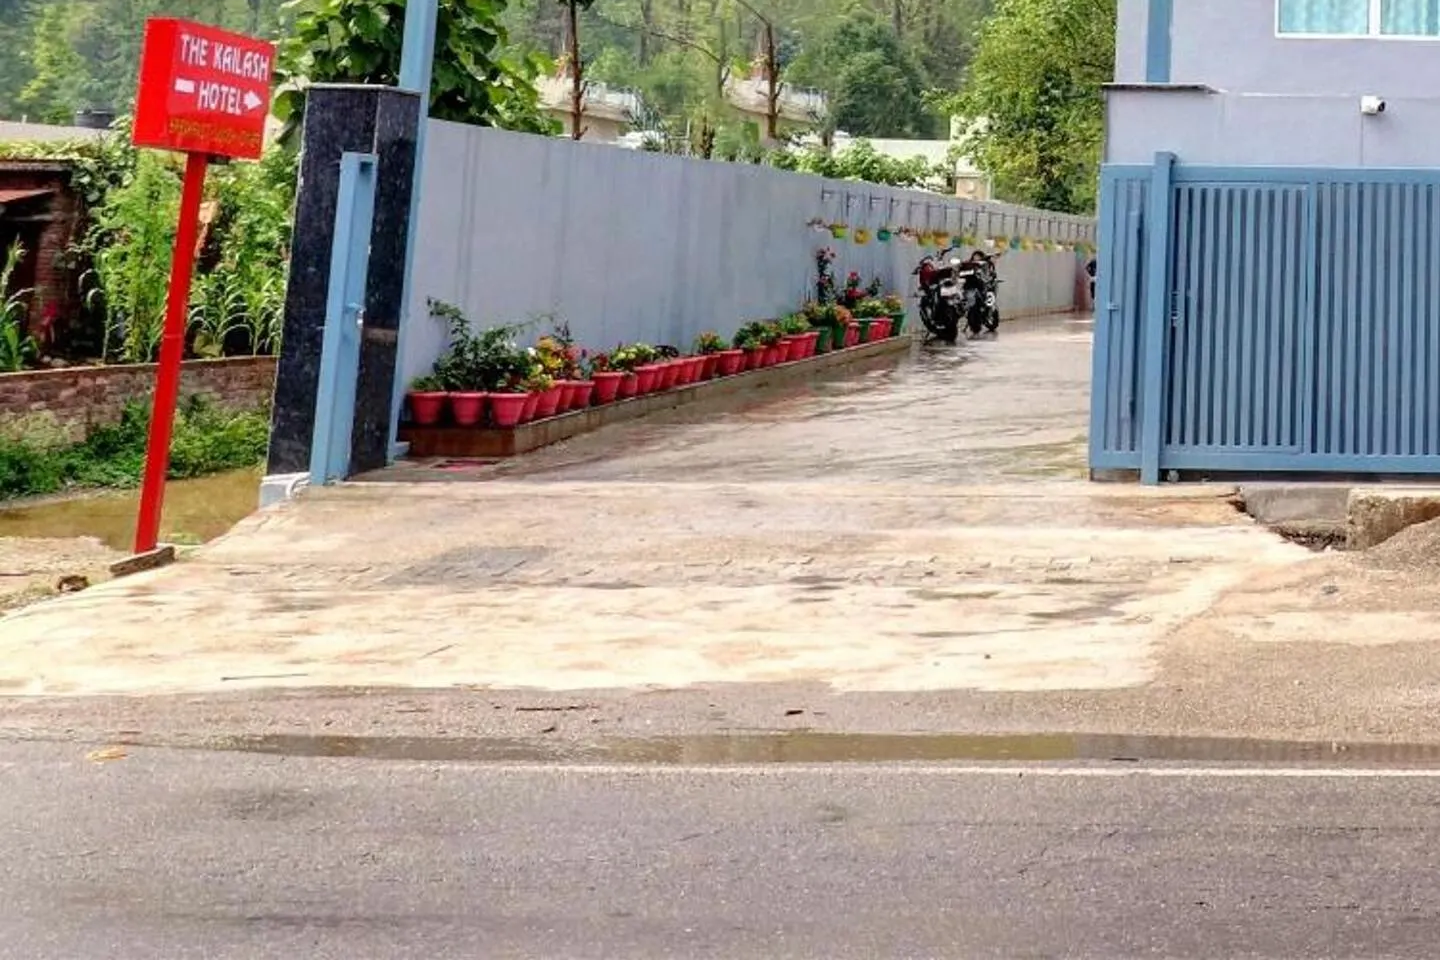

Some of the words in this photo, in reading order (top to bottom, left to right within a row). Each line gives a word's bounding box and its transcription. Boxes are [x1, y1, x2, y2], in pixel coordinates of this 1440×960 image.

[180, 34, 208, 67] THE
[213, 43, 270, 82] KAILASH
[197, 80, 242, 115] HOTEL
